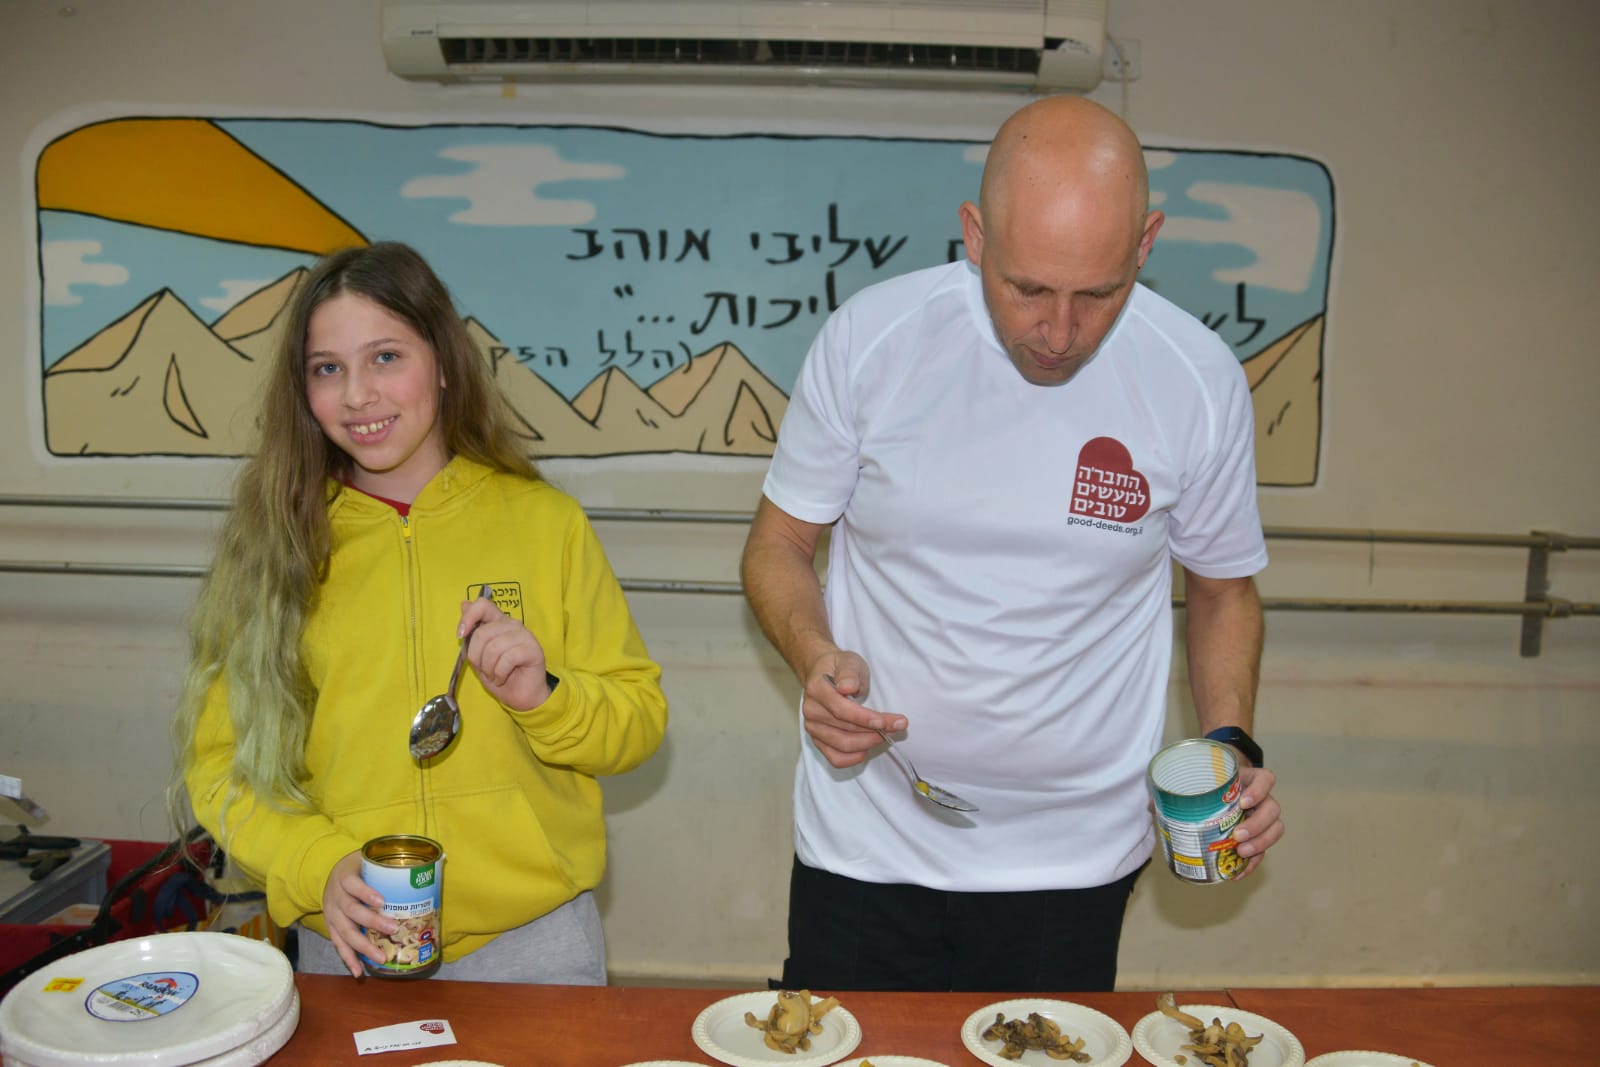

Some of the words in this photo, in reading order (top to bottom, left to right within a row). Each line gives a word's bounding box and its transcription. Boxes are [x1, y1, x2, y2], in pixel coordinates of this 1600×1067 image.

[566, 228, 711, 262] אוהב
[750, 203, 907, 267] שליבי
[490, 346, 569, 379] הזק
[1074, 498, 1127, 518] טובים
[1077, 482, 1146, 506] למעשים
